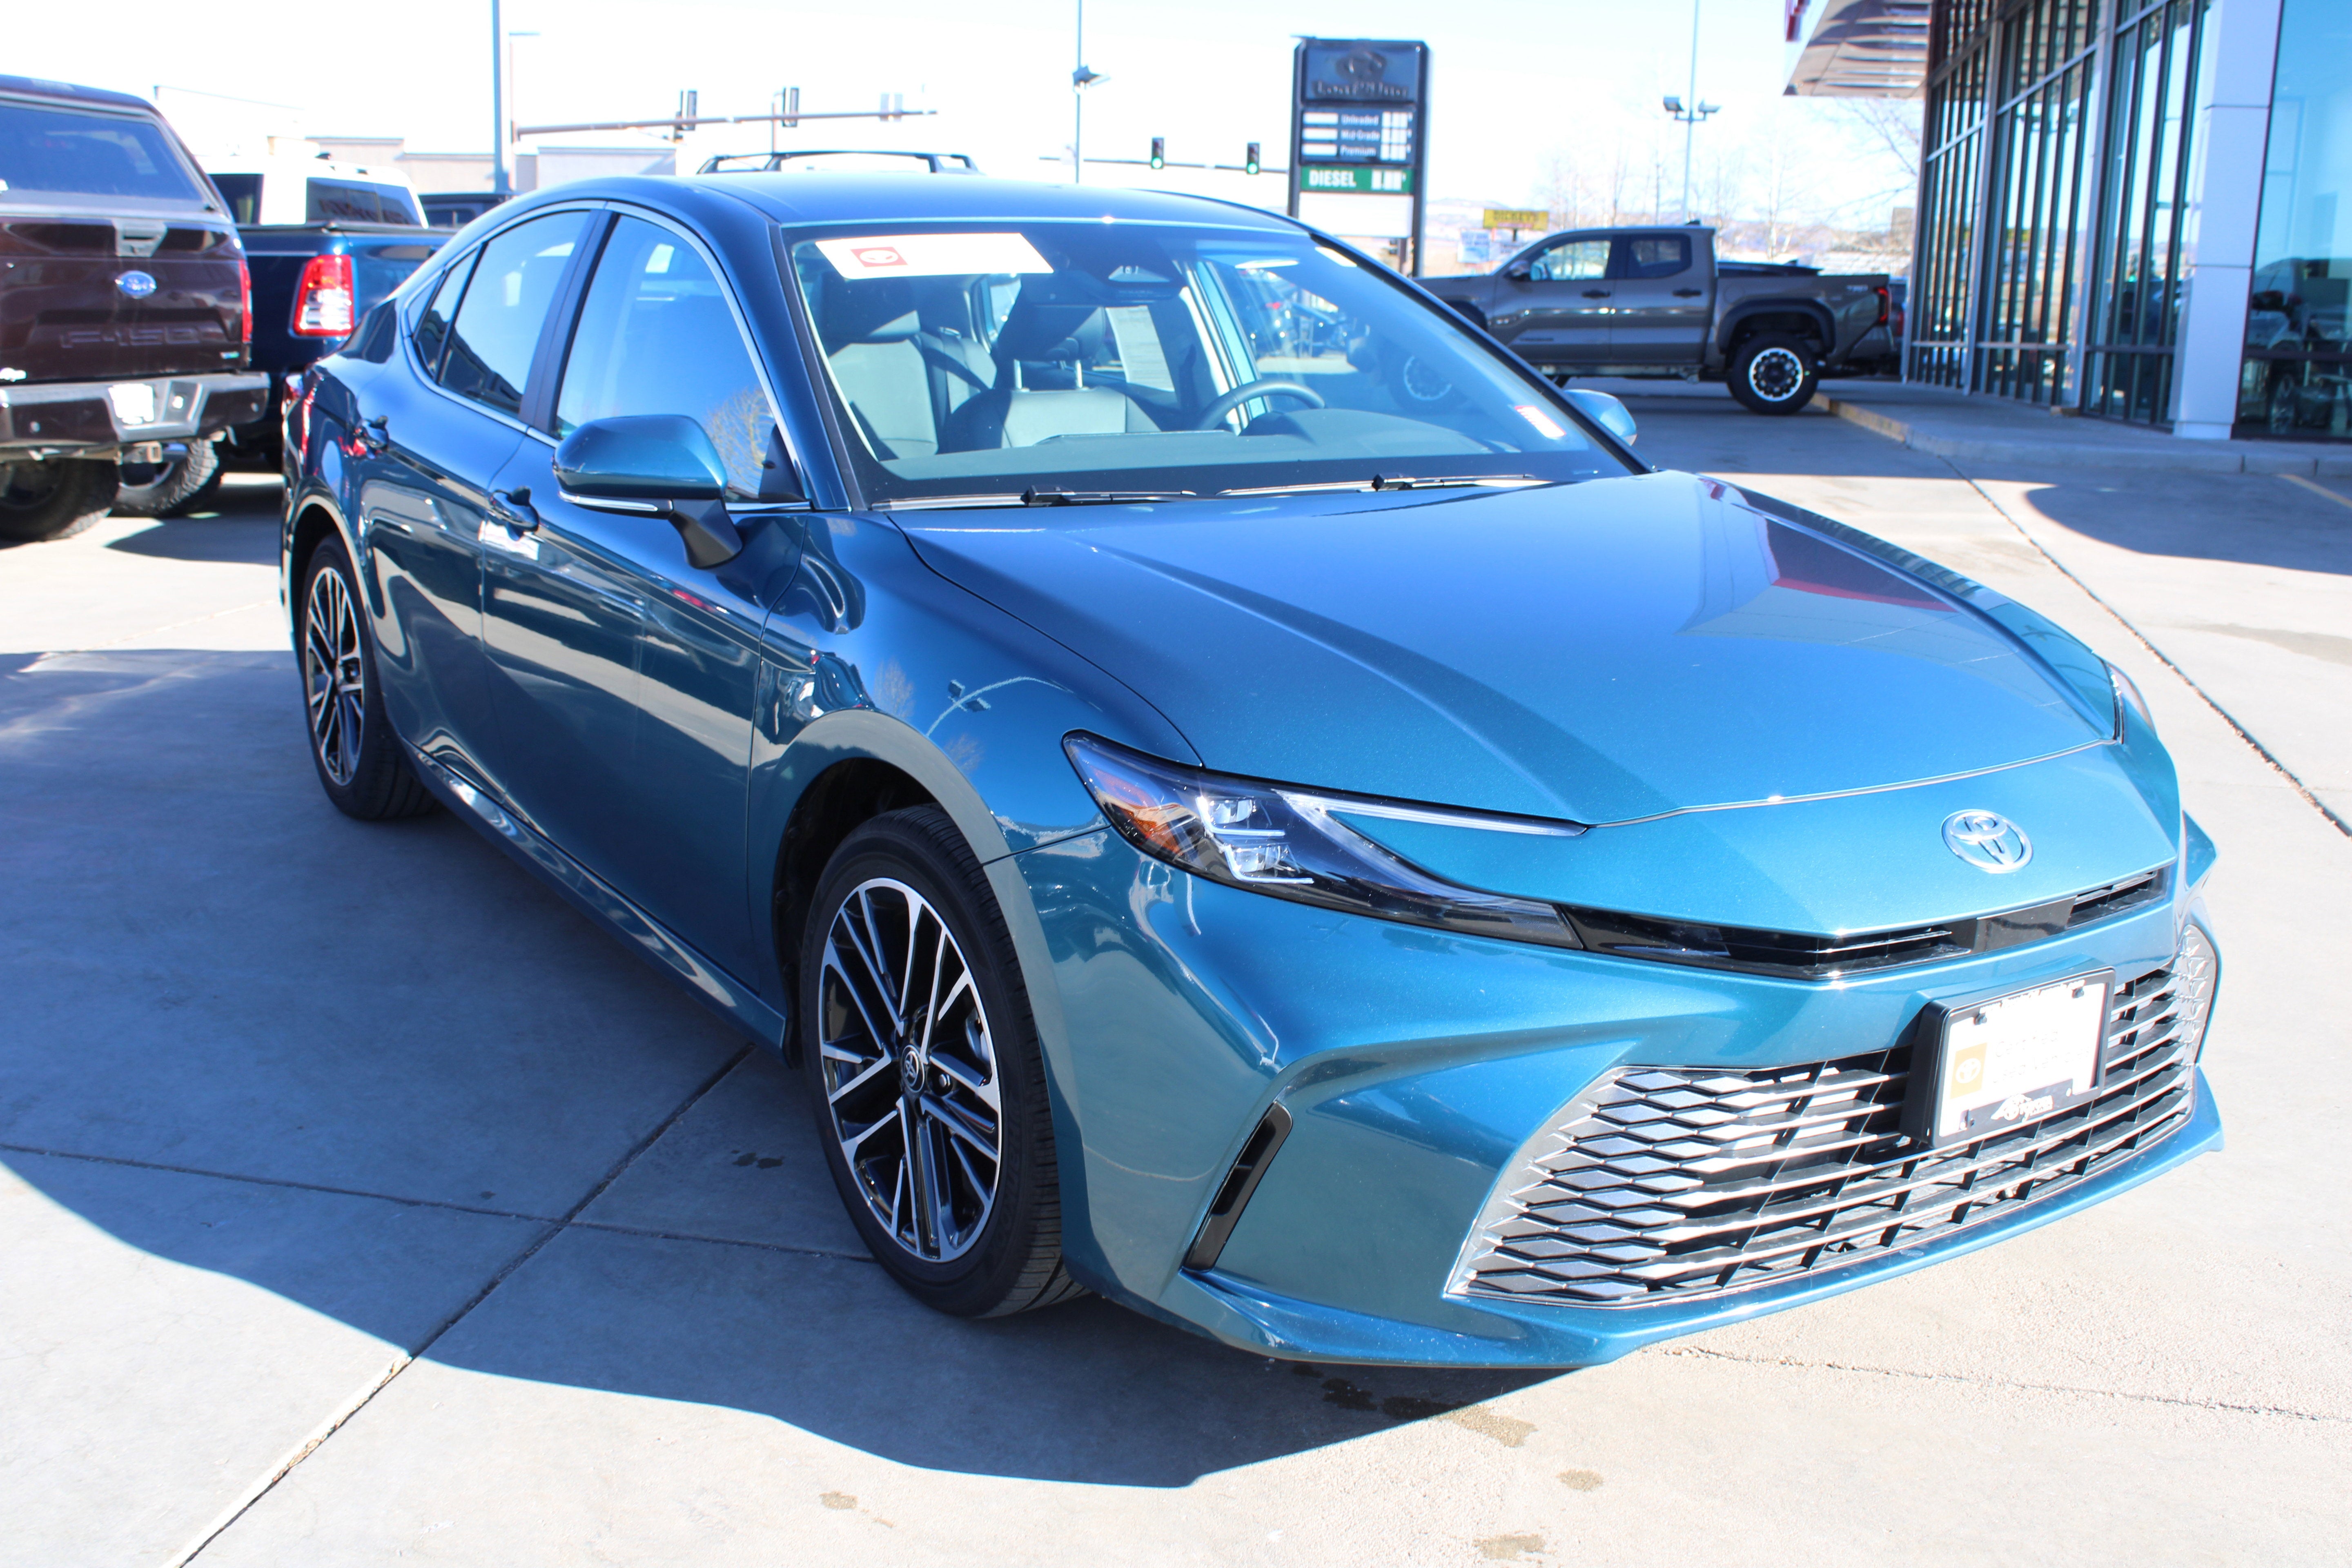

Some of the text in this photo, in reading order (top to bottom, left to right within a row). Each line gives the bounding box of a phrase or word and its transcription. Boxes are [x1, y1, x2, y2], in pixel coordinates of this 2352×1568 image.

[1341, 114, 1379, 126] Unleaded
[1340, 145, 1376, 156] Premium
[1309, 169, 1356, 188] DIESEL
